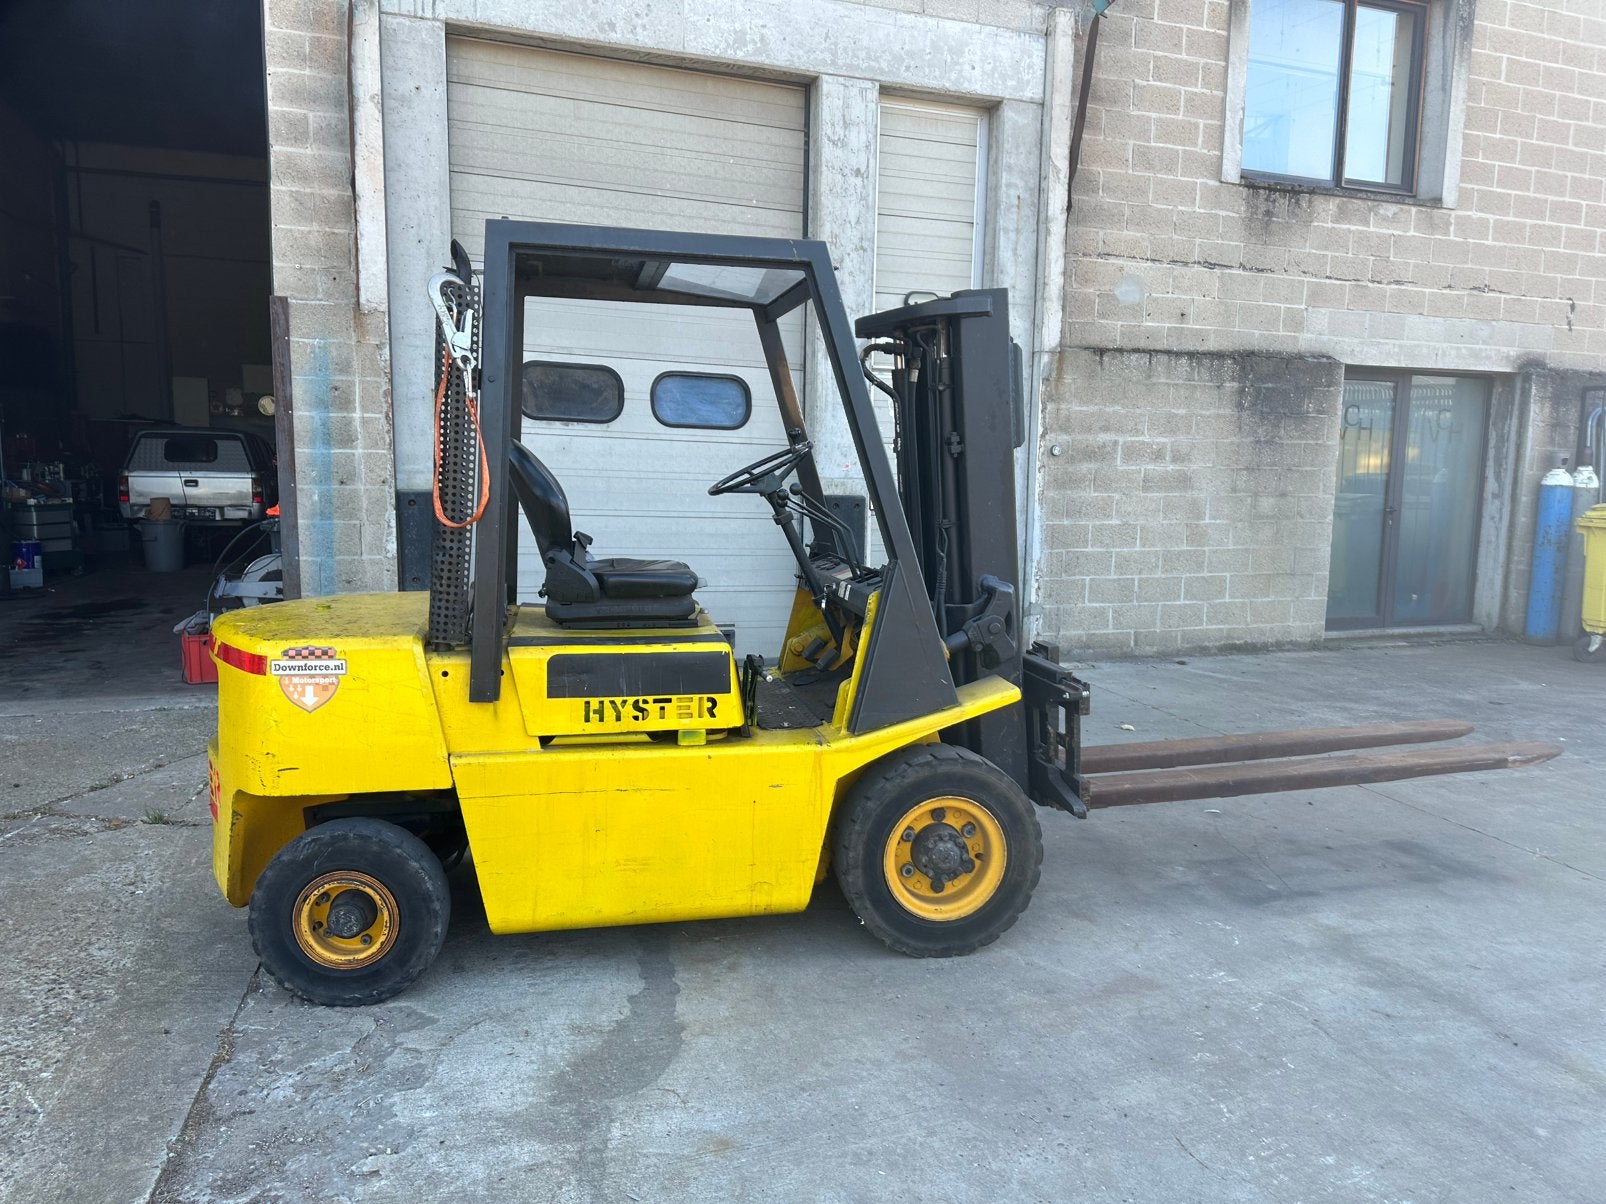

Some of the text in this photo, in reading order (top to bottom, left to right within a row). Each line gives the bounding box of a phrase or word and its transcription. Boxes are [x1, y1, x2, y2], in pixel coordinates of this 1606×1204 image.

[273, 662, 345, 672] Downforce.nl
[291, 676, 337, 686] Motorsport
[584, 696, 718, 723] HYSTER
